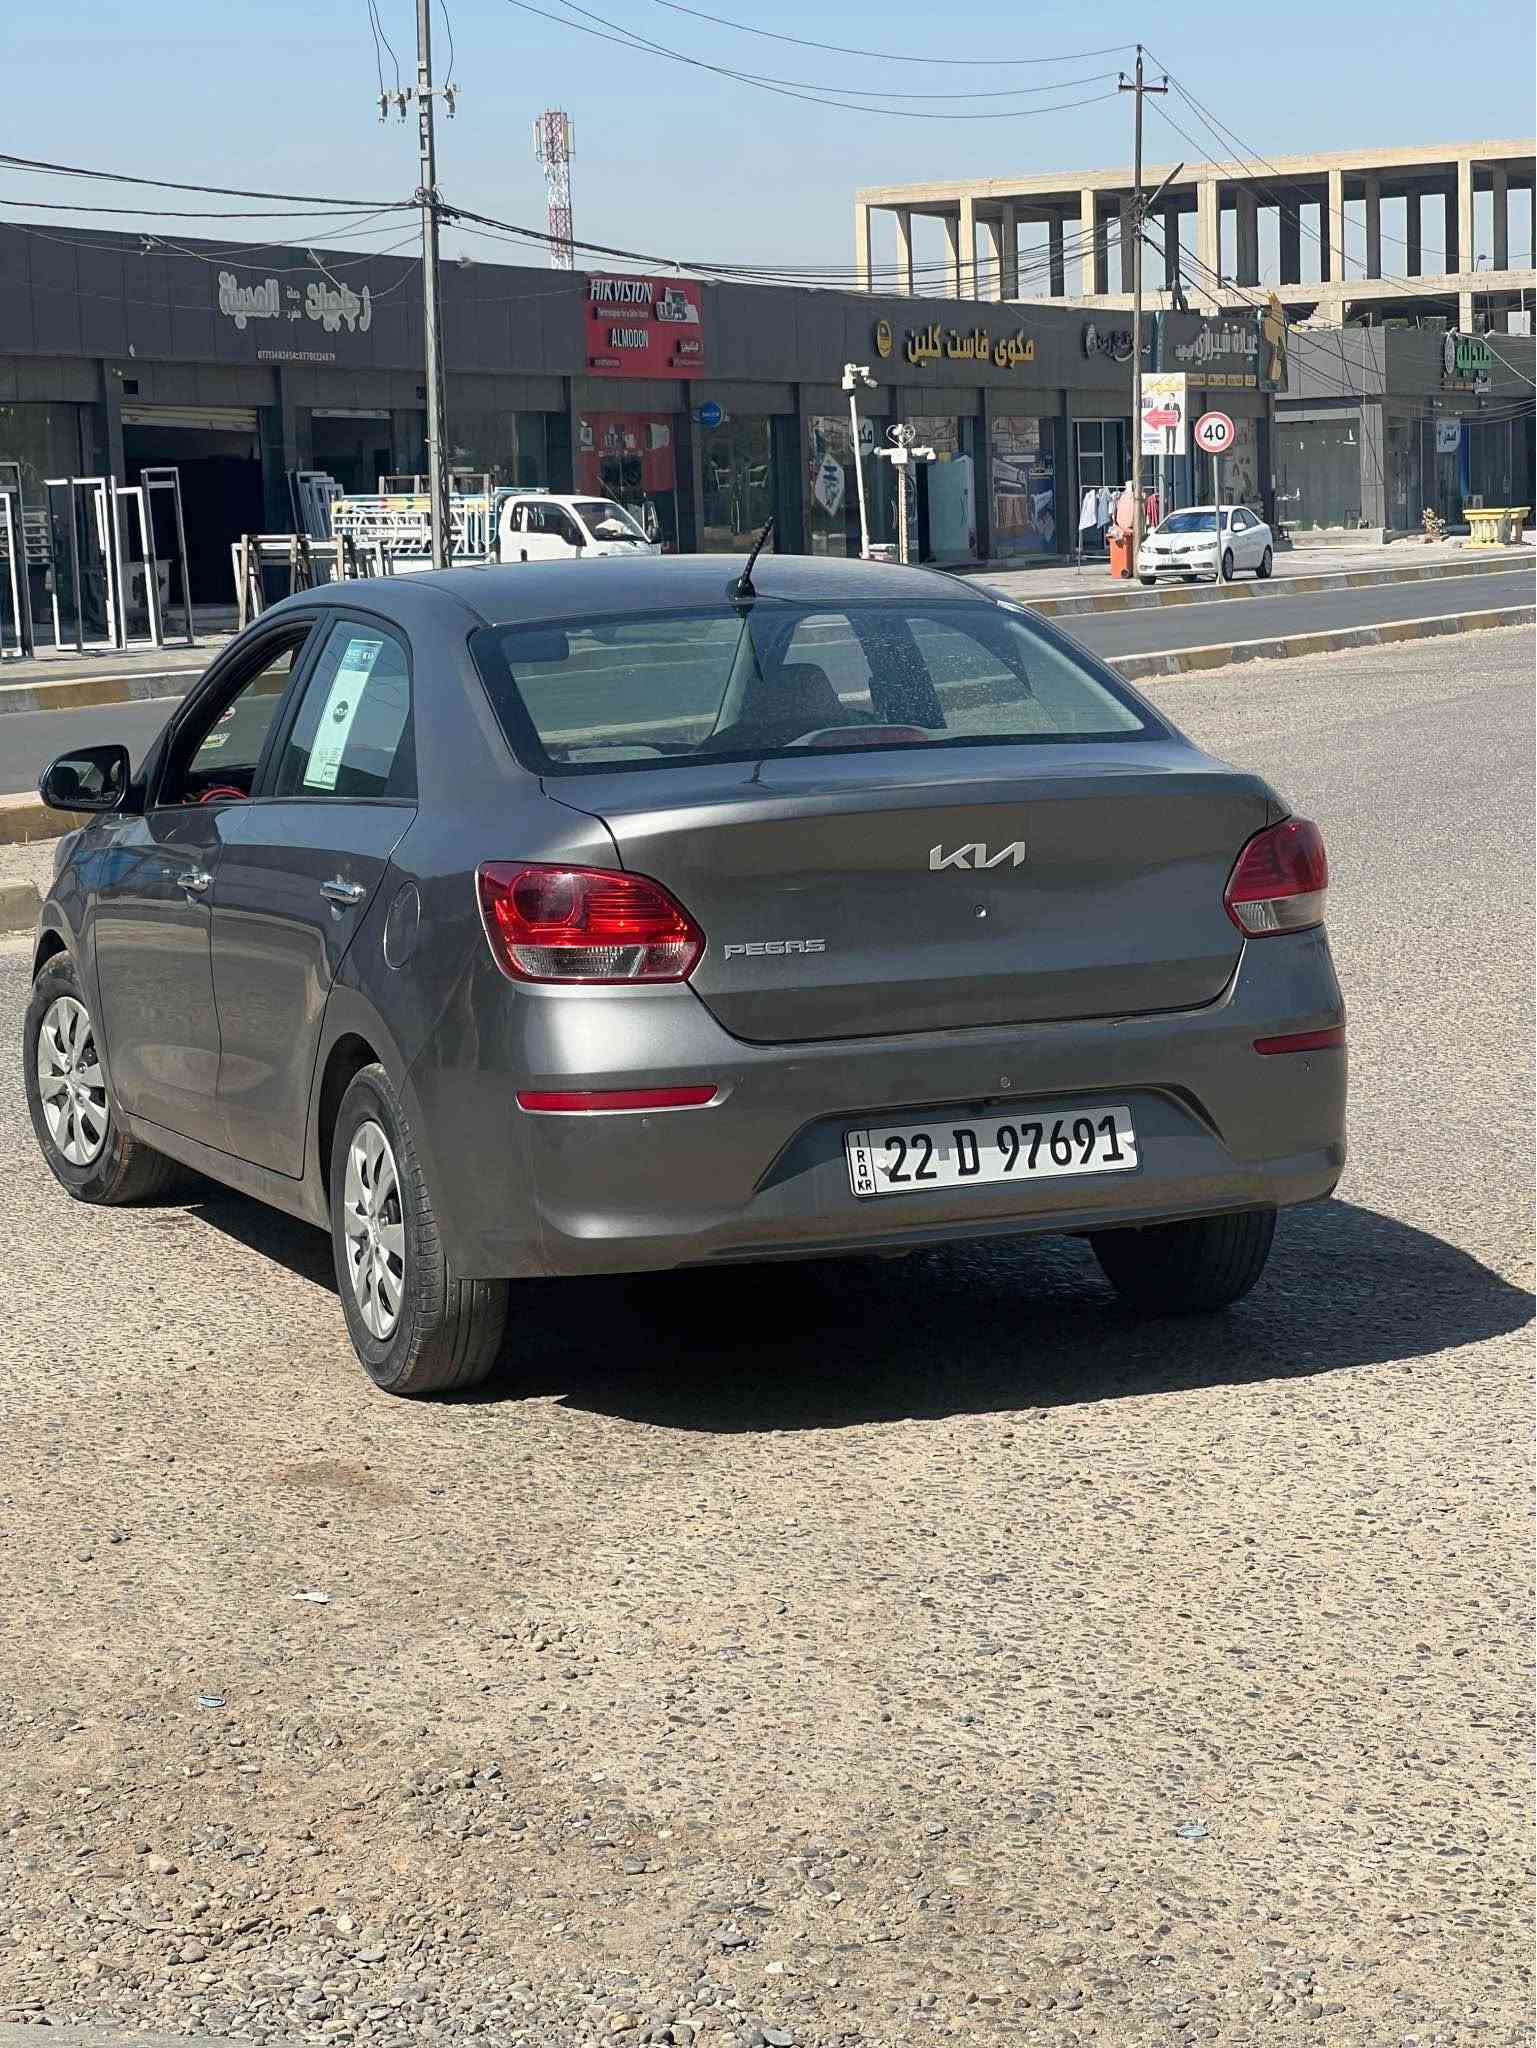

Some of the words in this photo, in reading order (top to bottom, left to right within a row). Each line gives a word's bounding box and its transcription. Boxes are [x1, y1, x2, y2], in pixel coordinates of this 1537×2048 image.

[590, 279, 653, 304] HIKVISION
[907, 324, 943, 367] كلين
[947, 328, 990, 360] فاست
[1204, 424, 1226, 441] 40
[929, 841, 1026, 870] KIA
[724, 939, 826, 960] PEGAS
[884, 1133, 937, 1183] 22
[952, 1128, 980, 1177] D
[996, 1115, 1125, 1173] 97691
[857, 1179, 873, 1192] KR
